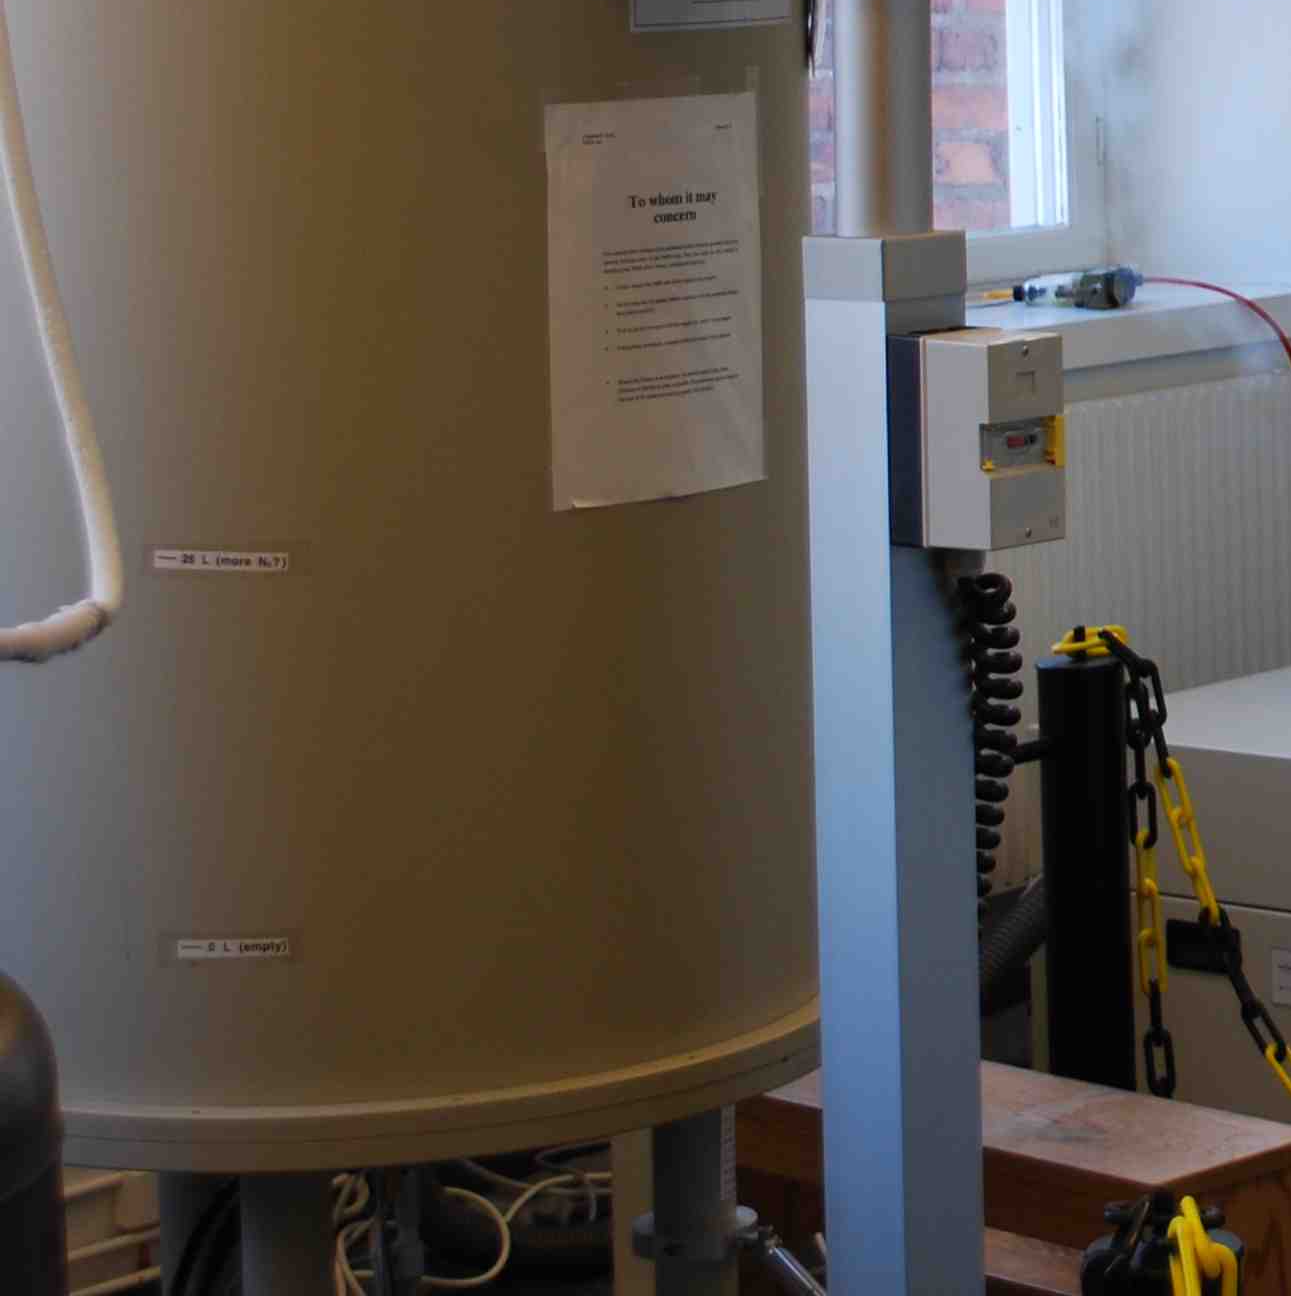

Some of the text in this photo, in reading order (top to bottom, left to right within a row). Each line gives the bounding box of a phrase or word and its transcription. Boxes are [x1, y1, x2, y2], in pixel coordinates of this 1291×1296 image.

[628, 194, 646, 209] To
[649, 191, 683, 208] whom
[695, 191, 719, 206] may
[653, 210, 697, 225] concern
[240, 941, 288, 954] (empty)
